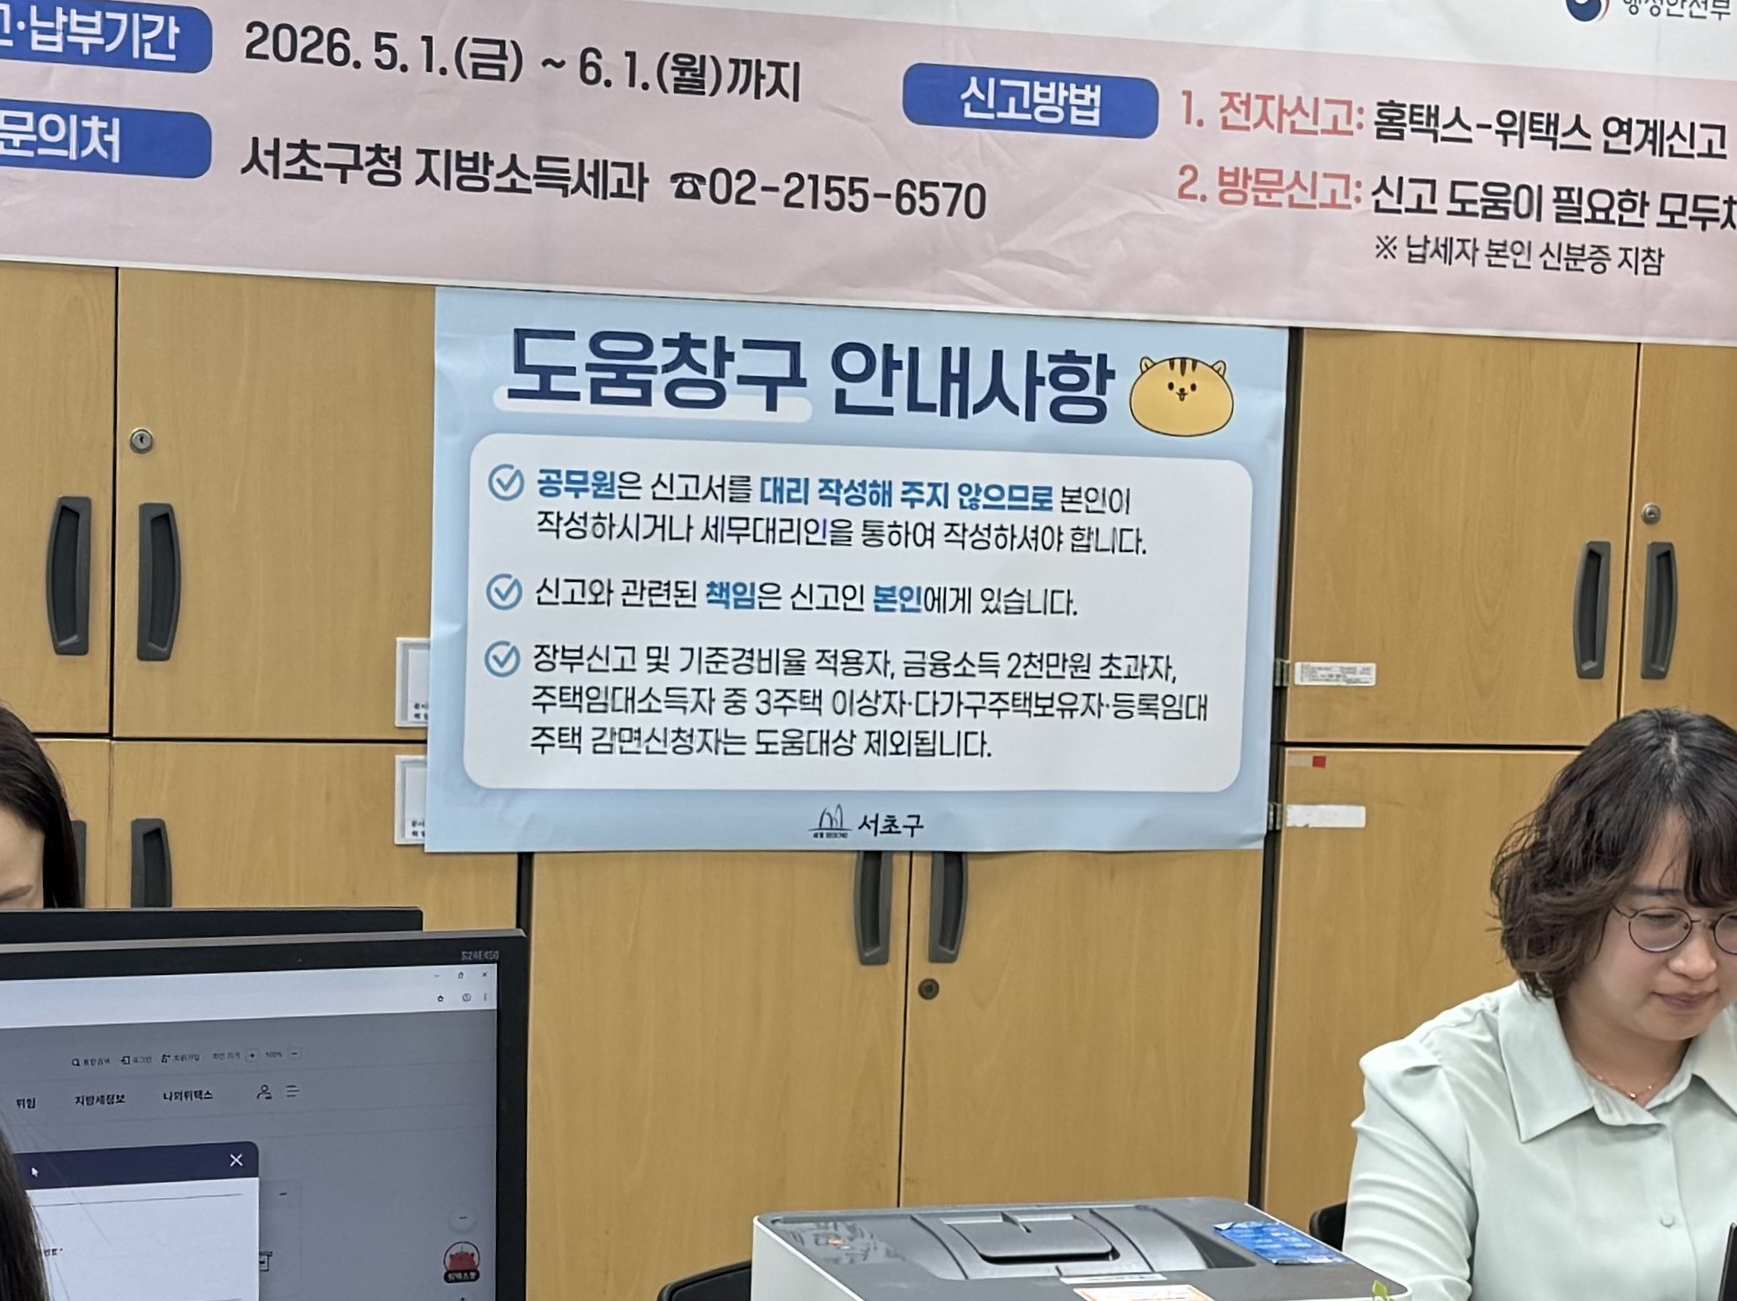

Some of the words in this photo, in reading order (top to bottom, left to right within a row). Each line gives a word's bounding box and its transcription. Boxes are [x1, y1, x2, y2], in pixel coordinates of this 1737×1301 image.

[244, 19, 363, 71] 2026.
[960, 75, 1103, 127] 신고방법
[1180, 90, 1206, 129] 1.
[1218, 90, 1366, 139] 전자신고:
[1373, 100, 1593, 152] 홈택스-위택스
[1602, 118, 1729, 161] 연계신고
[240, 136, 404, 188] 서초구청
[415, 147, 650, 204] 지방소득세과
[710, 166, 988, 221] 02-2155-6570
[1177, 163, 1209, 203] 2.
[1217, 164, 1364, 213] 방문신고:
[1371, 174, 1439, 218] 신고
[1446, 180, 1544, 225] 도움이
[1552, 184, 1650, 229] 필요한
[1406, 234, 1481, 268] 납세자
[1485, 240, 1533, 270] 본인
[1538, 241, 1612, 276] 신분증
[1616, 245, 1666, 277] 지참
[506, 327, 808, 413] 도움창구
[830, 341, 1116, 426] 안내사항
[537, 468, 642, 500] 공무원은
[650, 472, 753, 504] 신고서를
[760, 476, 810, 505] 대리
[818, 477, 893, 508] 작성해
[900, 481, 950, 510] 주지
[957, 483, 1054, 512] 않으므로
[1060, 485, 1131, 515] 본인이
[536, 510, 694, 543] 작성하시거나
[700, 514, 854, 547] 세무대리인을
[861, 519, 936, 549] 통하여
[943, 521, 1064, 553] 작성하셔야
[1070, 525, 1147, 555] 합니다.
[535, 577, 615, 608] 신고와
[621, 579, 697, 608] 관련된
[705, 581, 782, 610] 책임은
[790, 583, 865, 612] 신고인
[873, 584, 972, 615] 본인에게
[980, 587, 1078, 617] 있습니다.
[533, 643, 637, 674] 장부신고
[645, 645, 670, 675] 및
[679, 646, 808, 676] 기준경비율
[814, 648, 896, 680] 적용자,
[903, 650, 1001, 680] 금융소득
[1007, 652, 1091, 681] 2천만원
[1099, 653, 1178, 684] 초과자,
[531, 685, 716, 716] 주택임대소득자
[723, 687, 747, 716] 중
[755, 688, 823, 717] 3주택
[530, 725, 583, 755] 주택
[590, 726, 747, 756] 감면신청자는
[754, 729, 857, 758] 도움대상
[863, 729, 993, 759] 제외됩니다.
[857, 812, 925, 838] 서초구
